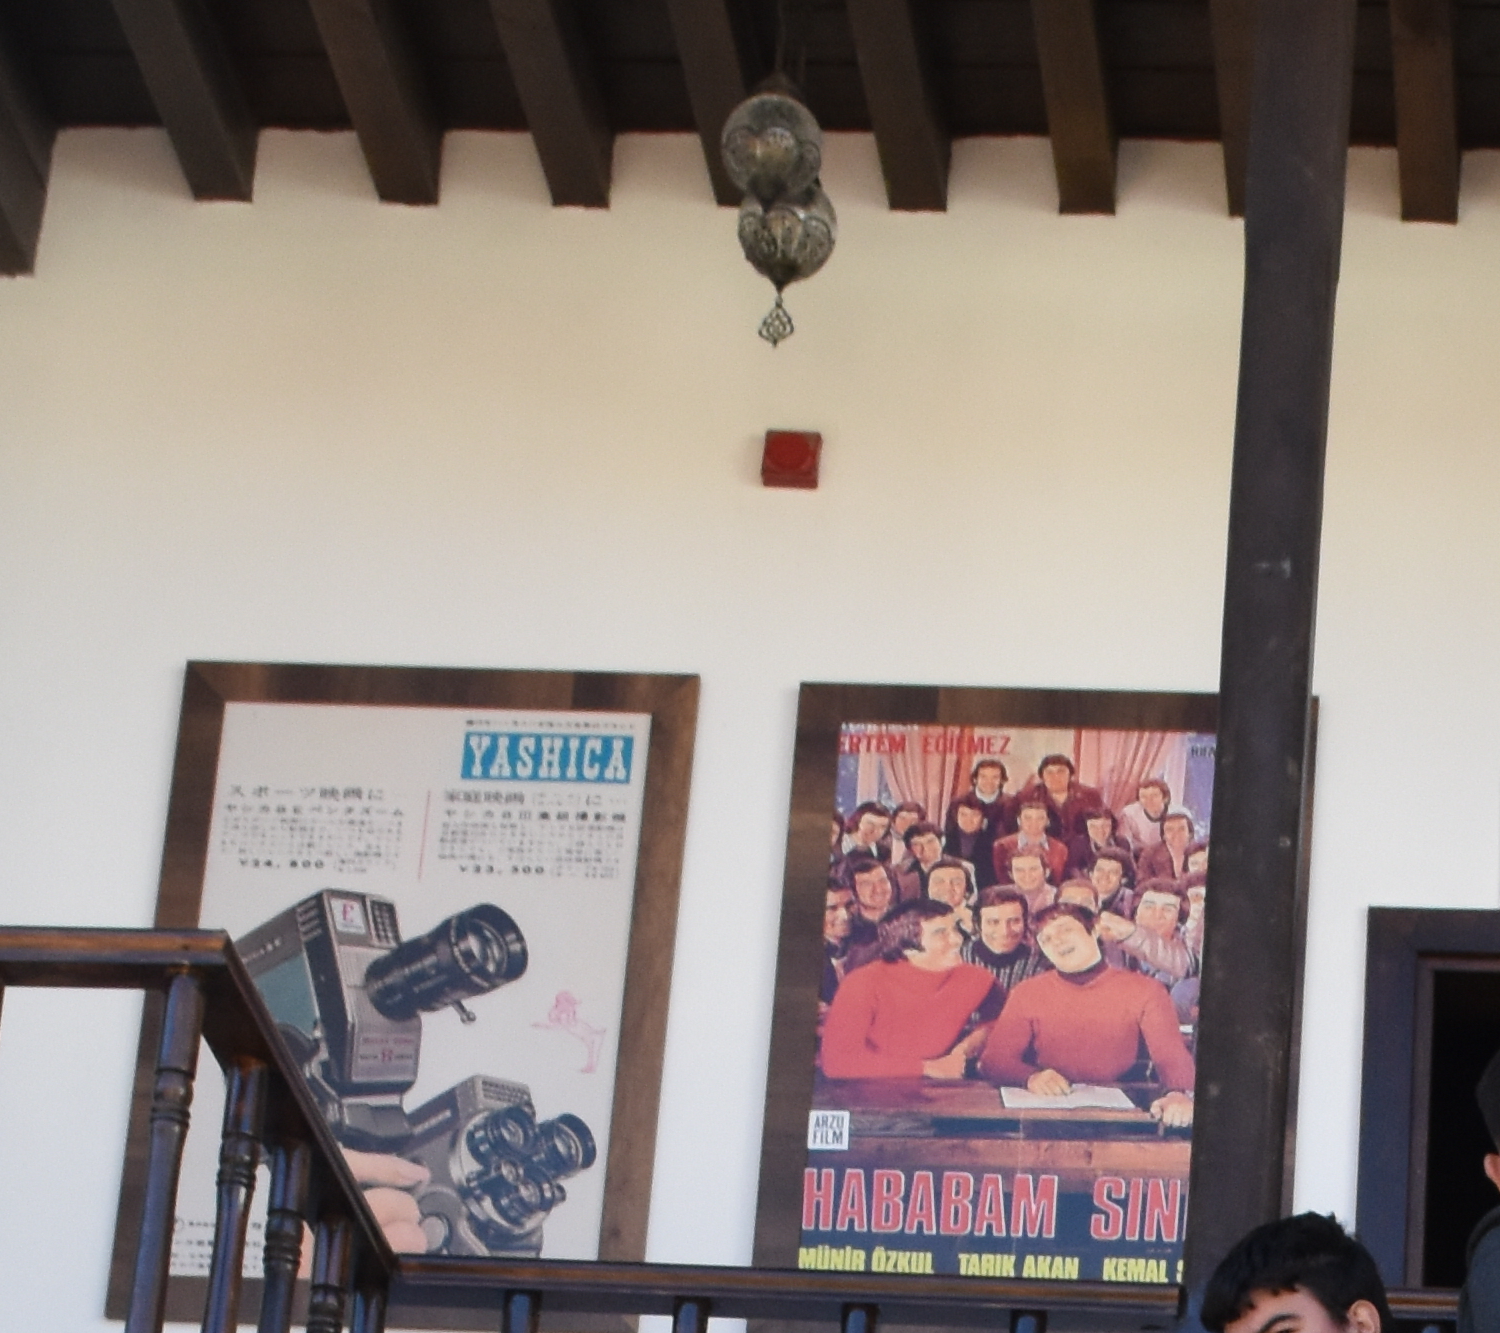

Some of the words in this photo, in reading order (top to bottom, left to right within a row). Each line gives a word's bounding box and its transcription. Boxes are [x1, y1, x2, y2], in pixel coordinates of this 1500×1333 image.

[469, 734, 627, 781] YASHICA
[814, 1114, 844, 1129] ARZU
[802, 1167, 1058, 1239] HABABAM
[1091, 1176, 1188, 1243] SIN
[799, 1245, 866, 1271] MÜNİR
[871, 1246, 934, 1274] ÖZKUL
[958, 1253, 1016, 1278] TARIK
[1022, 1255, 1079, 1280] AKAN
[1102, 1257, 1169, 1284] KEMAL
